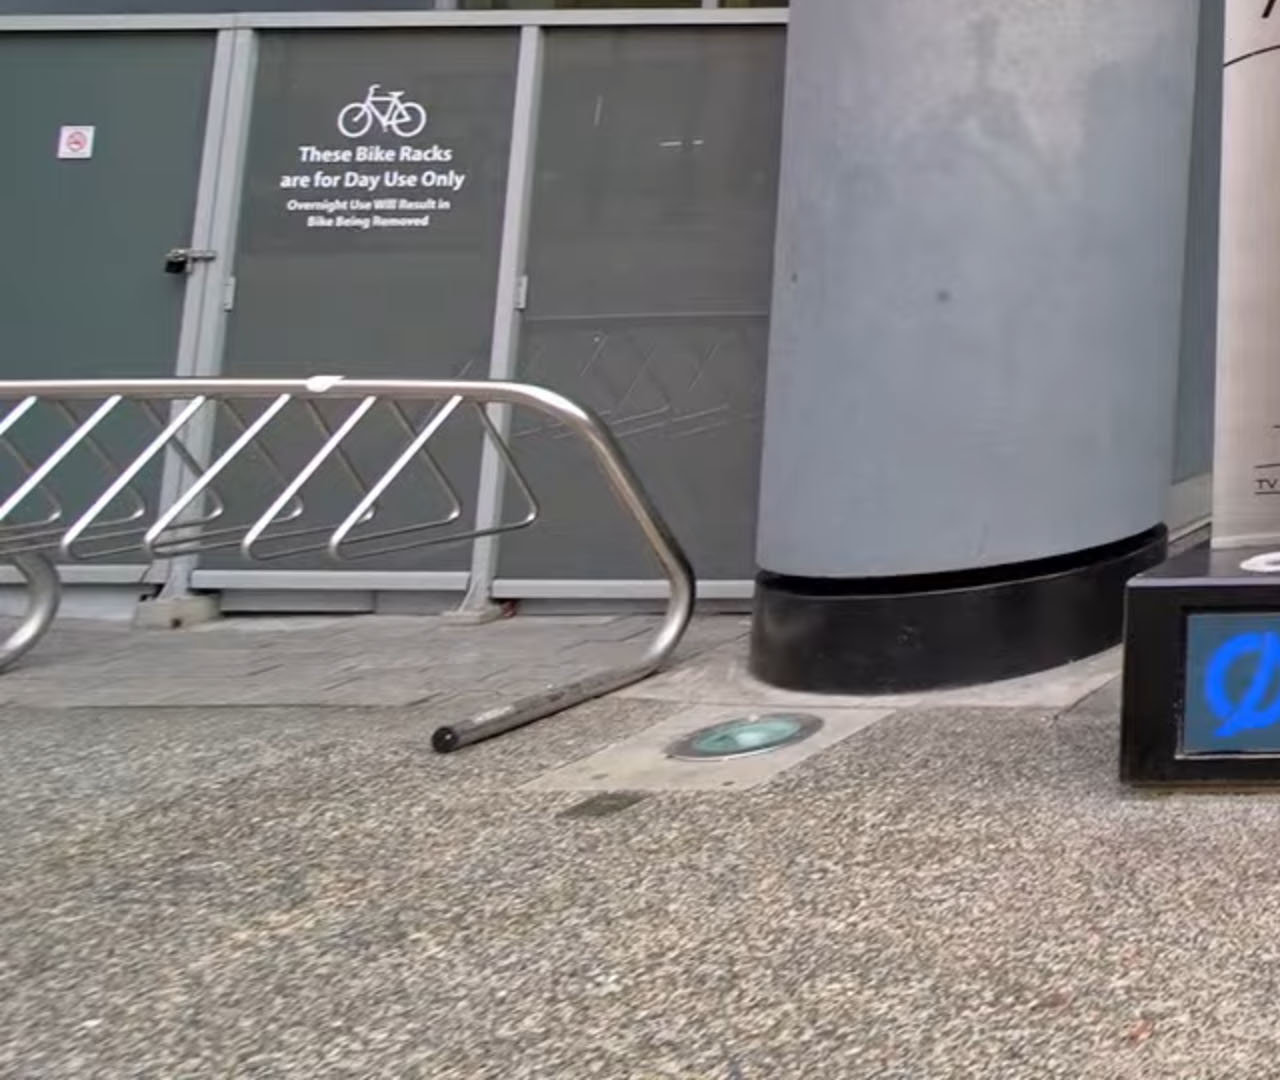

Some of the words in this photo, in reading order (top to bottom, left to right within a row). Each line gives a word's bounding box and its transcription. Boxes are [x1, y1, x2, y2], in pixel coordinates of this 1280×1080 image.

[299, 146, 352, 162] These
[355, 145, 396, 162] Bike
[399, 145, 453, 162] Racks
[280, 174, 310, 188] are
[313, 171, 341, 187] for
[344, 171, 380, 191] Day
[383, 171, 418, 187] Use
[421, 170, 466, 191] Only
[286, 199, 348, 213] Overnight
[350, 199, 372, 210] Use
[398, 198, 436, 210] Result
[438, 198, 451, 210] in
[307, 215, 334, 227] Bike
[335, 215, 371, 229] Being
[372, 215, 430, 227] Removed
[1256, 479, 1278, 489] TV
